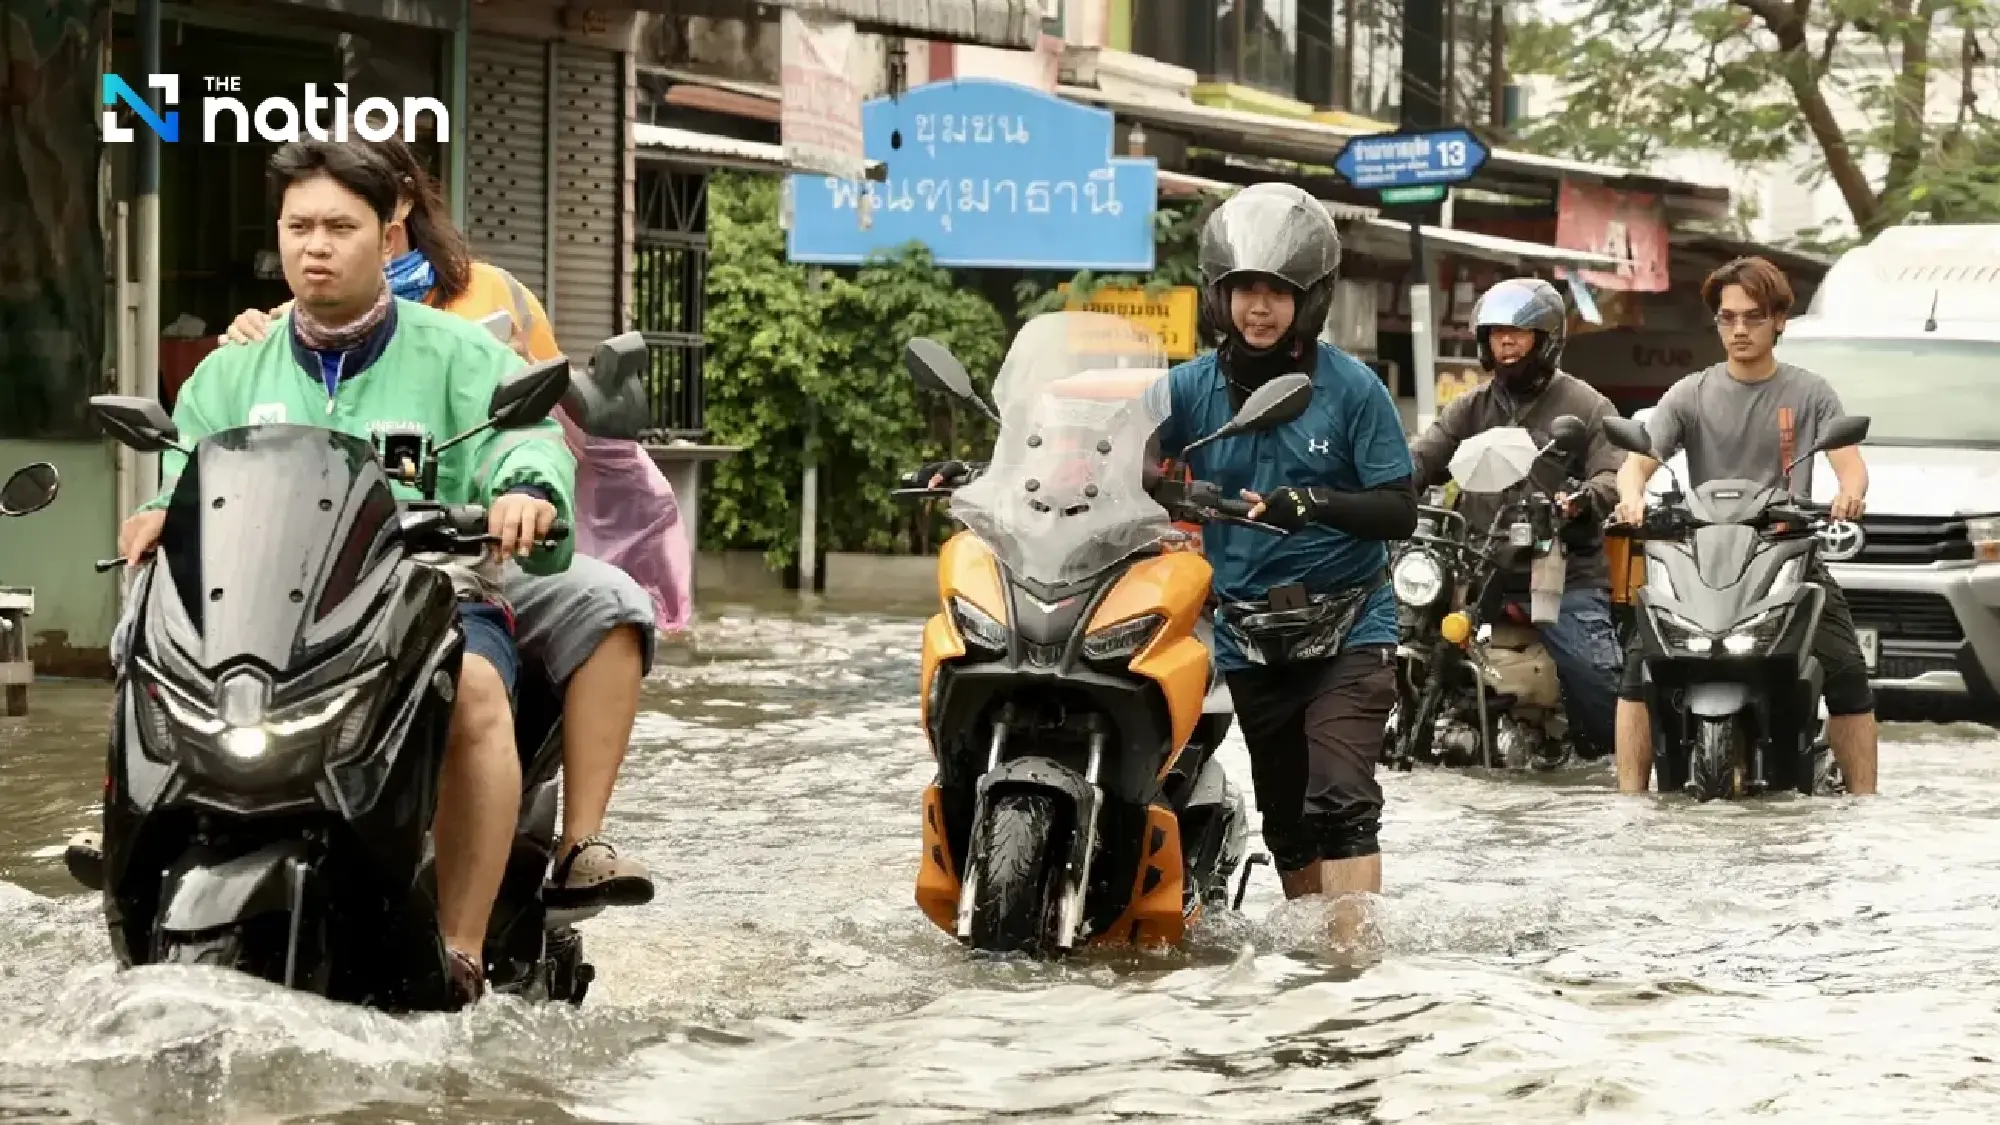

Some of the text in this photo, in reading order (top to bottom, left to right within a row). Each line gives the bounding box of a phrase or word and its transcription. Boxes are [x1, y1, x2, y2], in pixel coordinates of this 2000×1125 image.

[915, 113, 1030, 159] ชุมชน
[1436, 140, 1466, 167] 13
[1632, 342, 1694, 368] true
